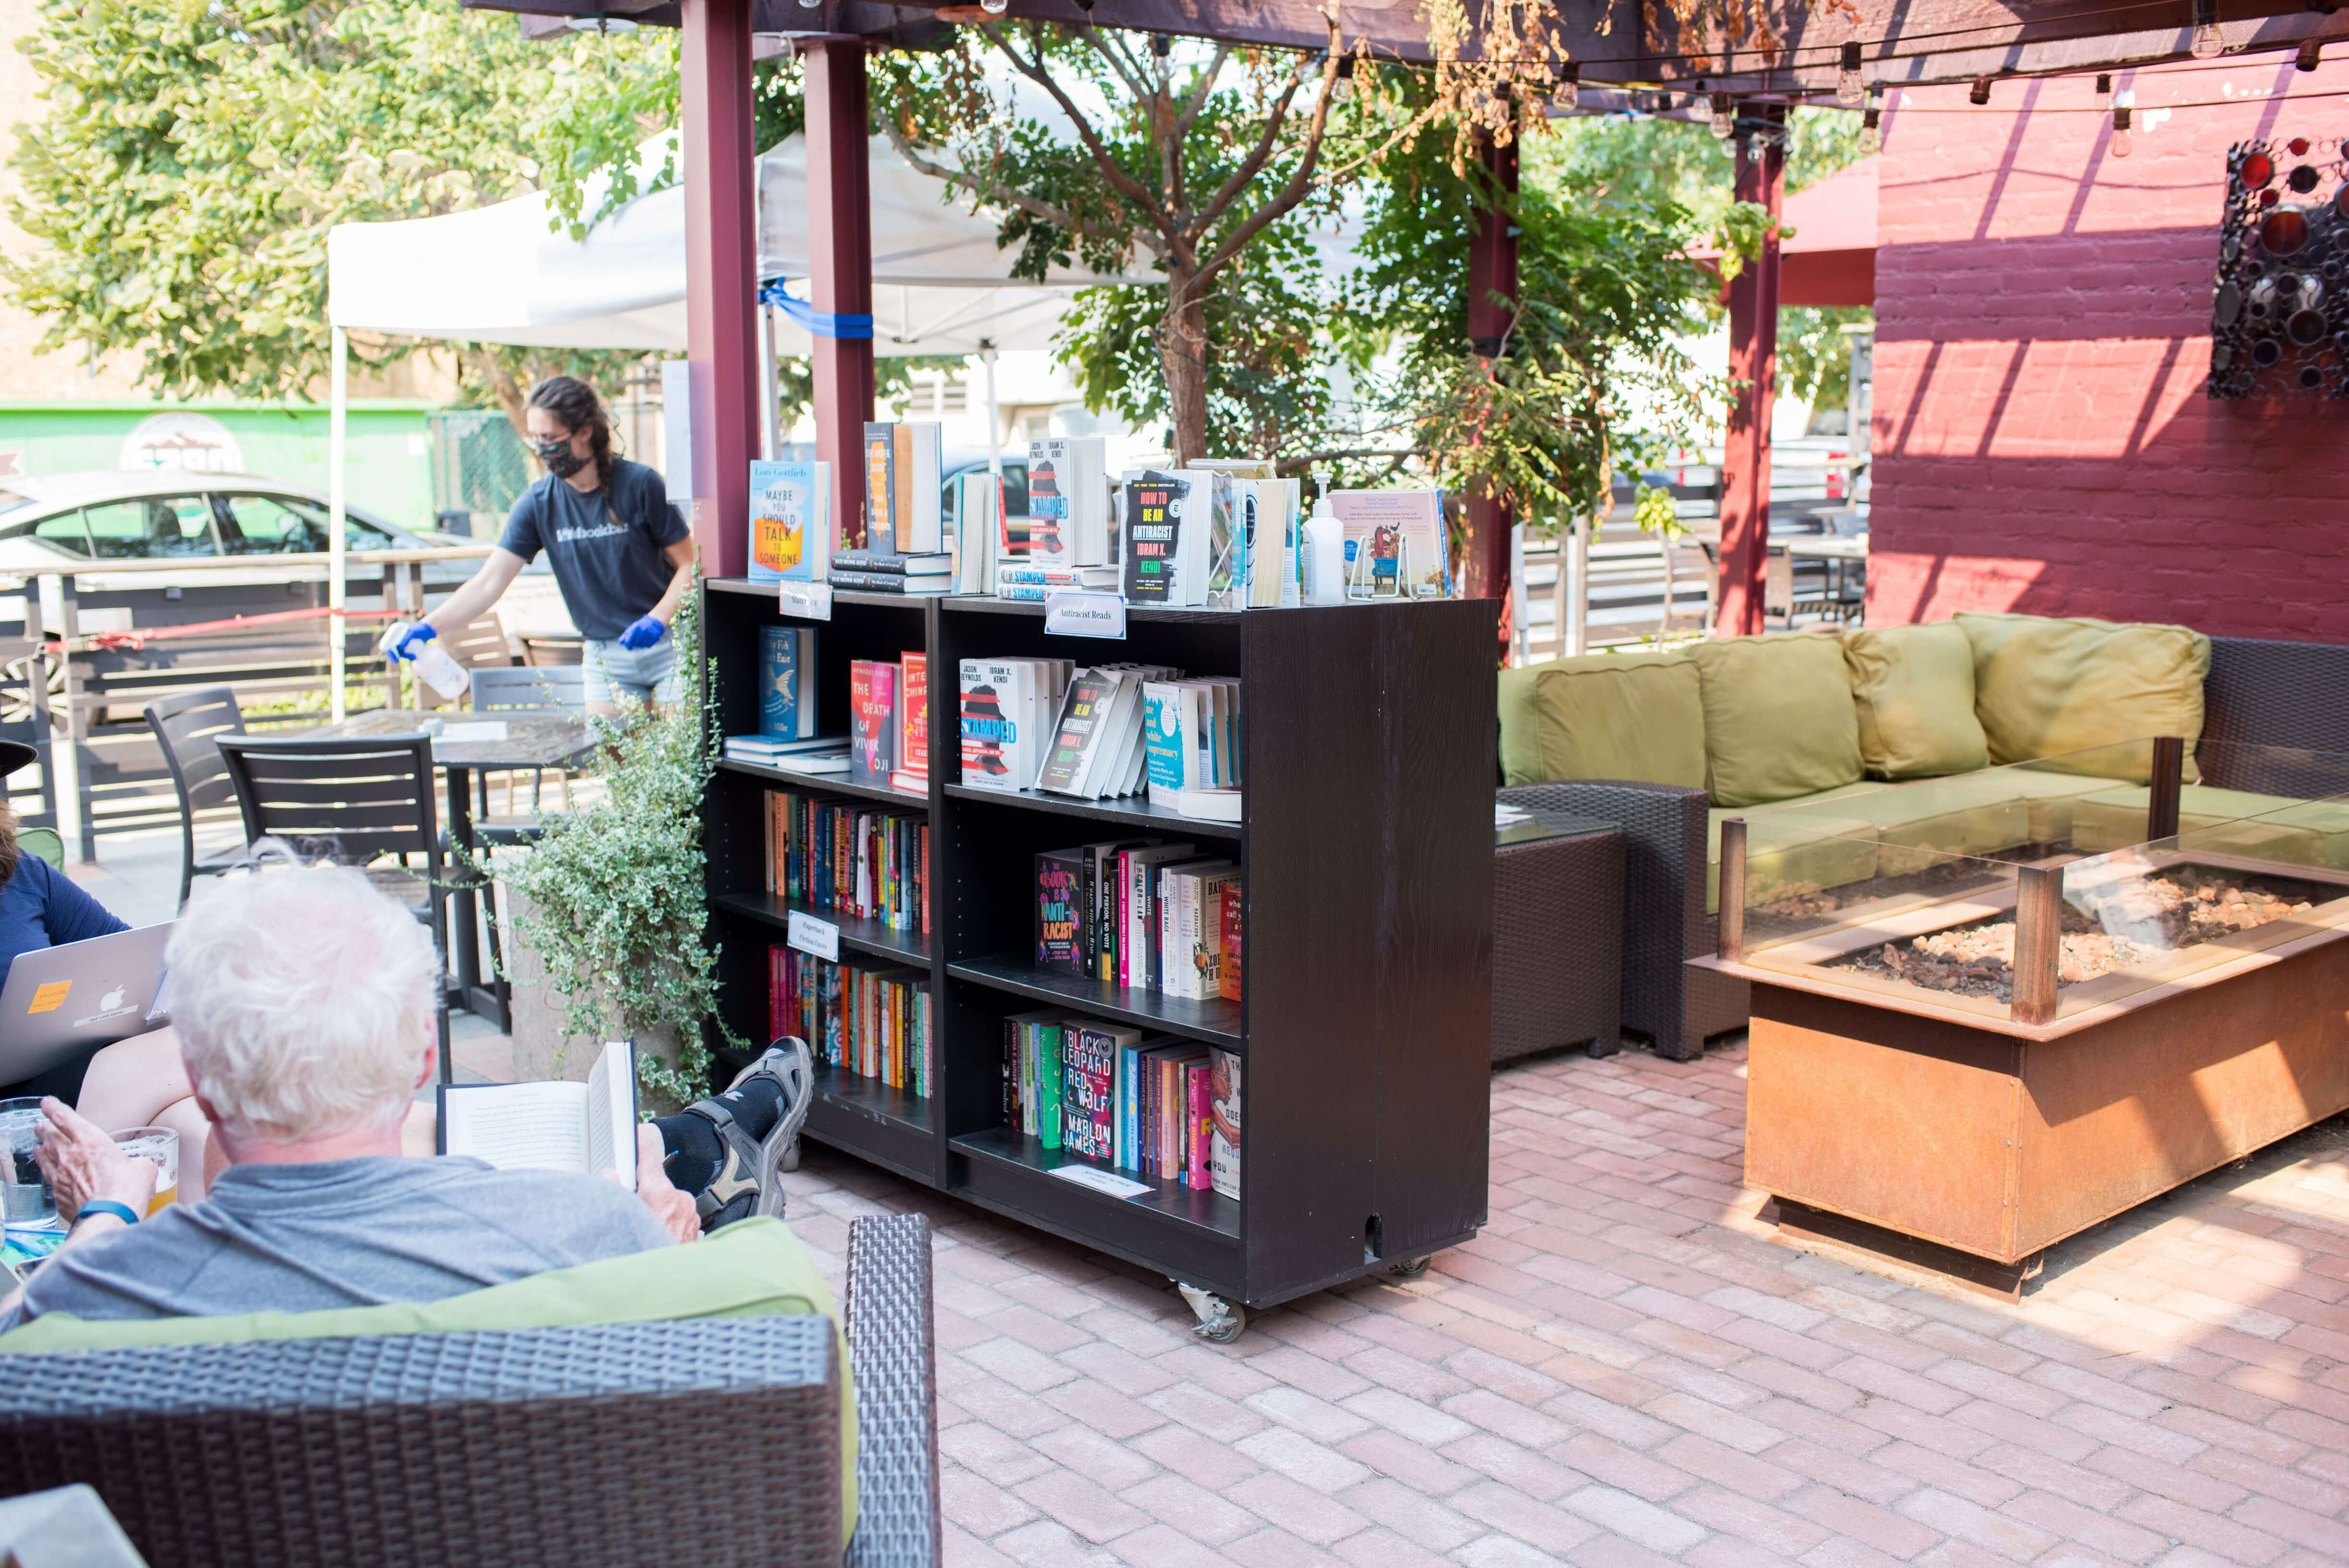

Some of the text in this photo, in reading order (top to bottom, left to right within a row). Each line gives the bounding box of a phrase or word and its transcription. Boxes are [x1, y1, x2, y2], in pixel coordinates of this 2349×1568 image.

[754, 468, 806, 476] Lori Gottlieb
[766, 490, 792, 501] MAYBE
[1141, 492, 1167, 504] HOW TO
[773, 503, 786, 511] YOU
[1029, 497, 1068, 519] STAMPED
[763, 513, 795, 524] SHOULD
[1143, 509, 1163, 522] BE AN
[765, 527, 791, 541] TALK
[1133, 525, 1172, 539] ANTIRACIST
[1137, 543, 1166, 556] IBRAM X.
[760, 554, 797, 564] SOMEONE
[1141, 560, 1160, 573] KENDI
[1015, 571, 1045, 582] STAMPED
[1014, 588, 1043, 599] STAMPED
[1060, 609, 1111, 620] Antiracist Reads
[990, 667, 1004, 675] IBRAM
[853, 682, 869, 695] THE
[863, 702, 889, 717] DEATH
[859, 721, 870, 732] OF
[1147, 718, 1156, 727] and
[961, 718, 1017, 744] STAMPED
[1147, 731, 1162, 743] white
[855, 736, 879, 752] VIVEK
[1148, 746, 1179, 760] supremacy
[875, 759, 888, 772] OJI
[1045, 871, 1068, 888] BOOK
[1054, 889, 1059, 900] IS
[1045, 903, 1070, 921] ANTI-
[803, 921, 825, 935] Paperback
[1044, 922, 1073, 939] RACIST
[1104, 922, 1109, 931] NO
[799, 935, 813, 945] Fiction
[1068, 1030, 1099, 1056] BLACK
[1063, 1046, 1110, 1076] LEOPARD
[1231, 1060, 1240, 1071] TH
[1068, 1068, 1086, 1090] RED
[1079, 1088, 1107, 1113] WOLF
[1068, 1114, 1110, 1143] MARLON
[1063, 1129, 1095, 1156] JAMES
[1213, 1160, 1226, 1173] YOU
